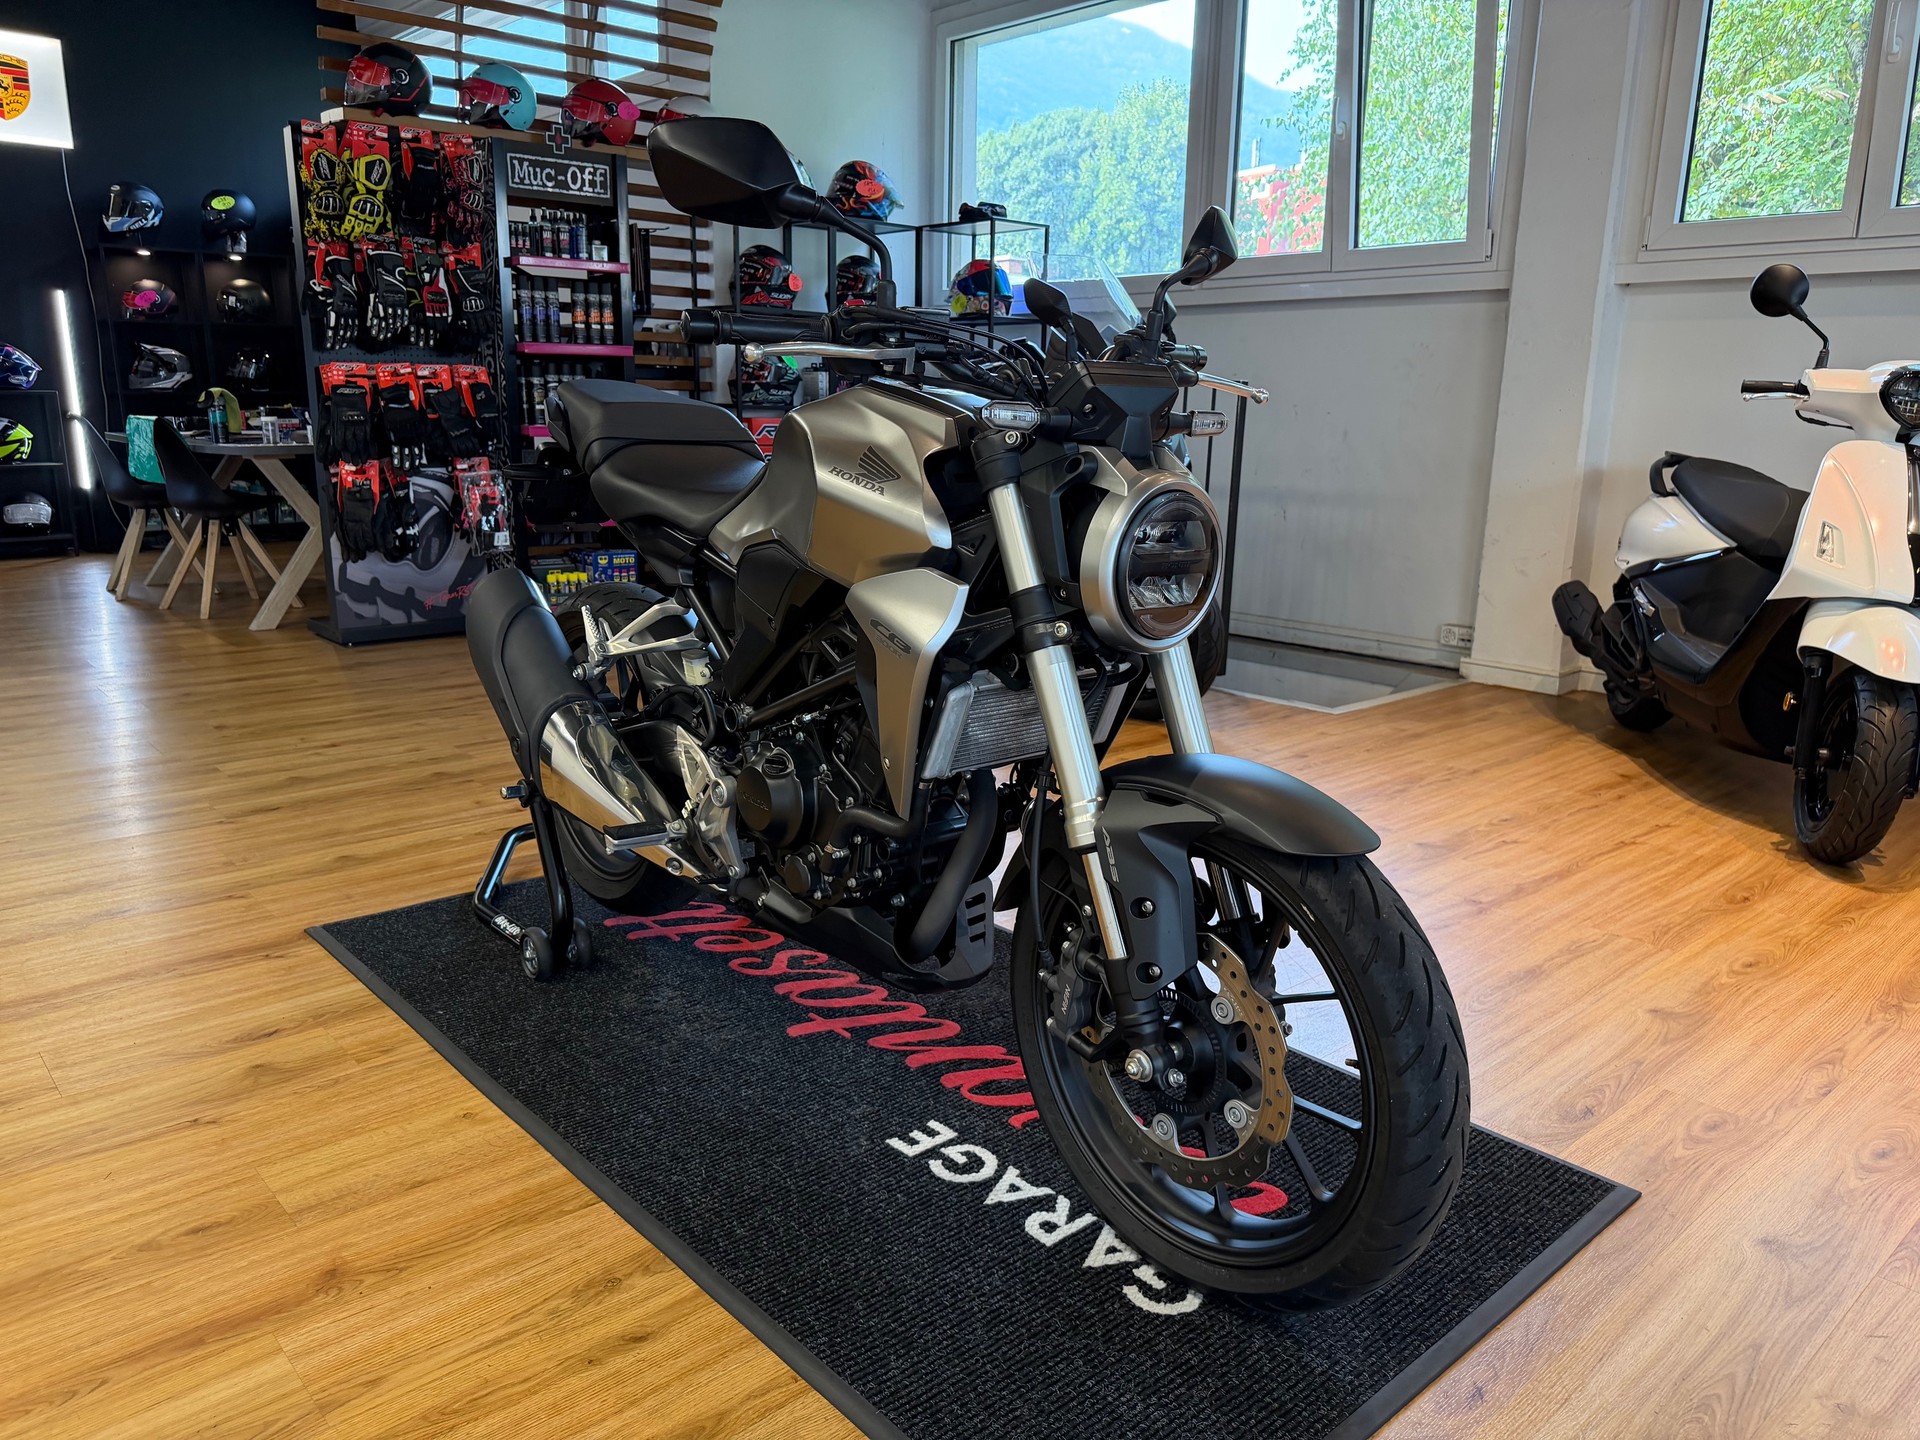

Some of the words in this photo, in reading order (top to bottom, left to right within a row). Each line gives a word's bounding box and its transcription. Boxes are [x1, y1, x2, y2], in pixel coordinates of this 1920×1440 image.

[354, 123, 386, 133] RST
[512, 159, 606, 194] Muc-Off
[334, 363, 363, 371] RST
[828, 465, 885, 497] HONDA
[870, 618, 912, 655] CB
[1101, 825, 1120, 883] ABS
[885, 1119, 1204, 1315] GARAGE
